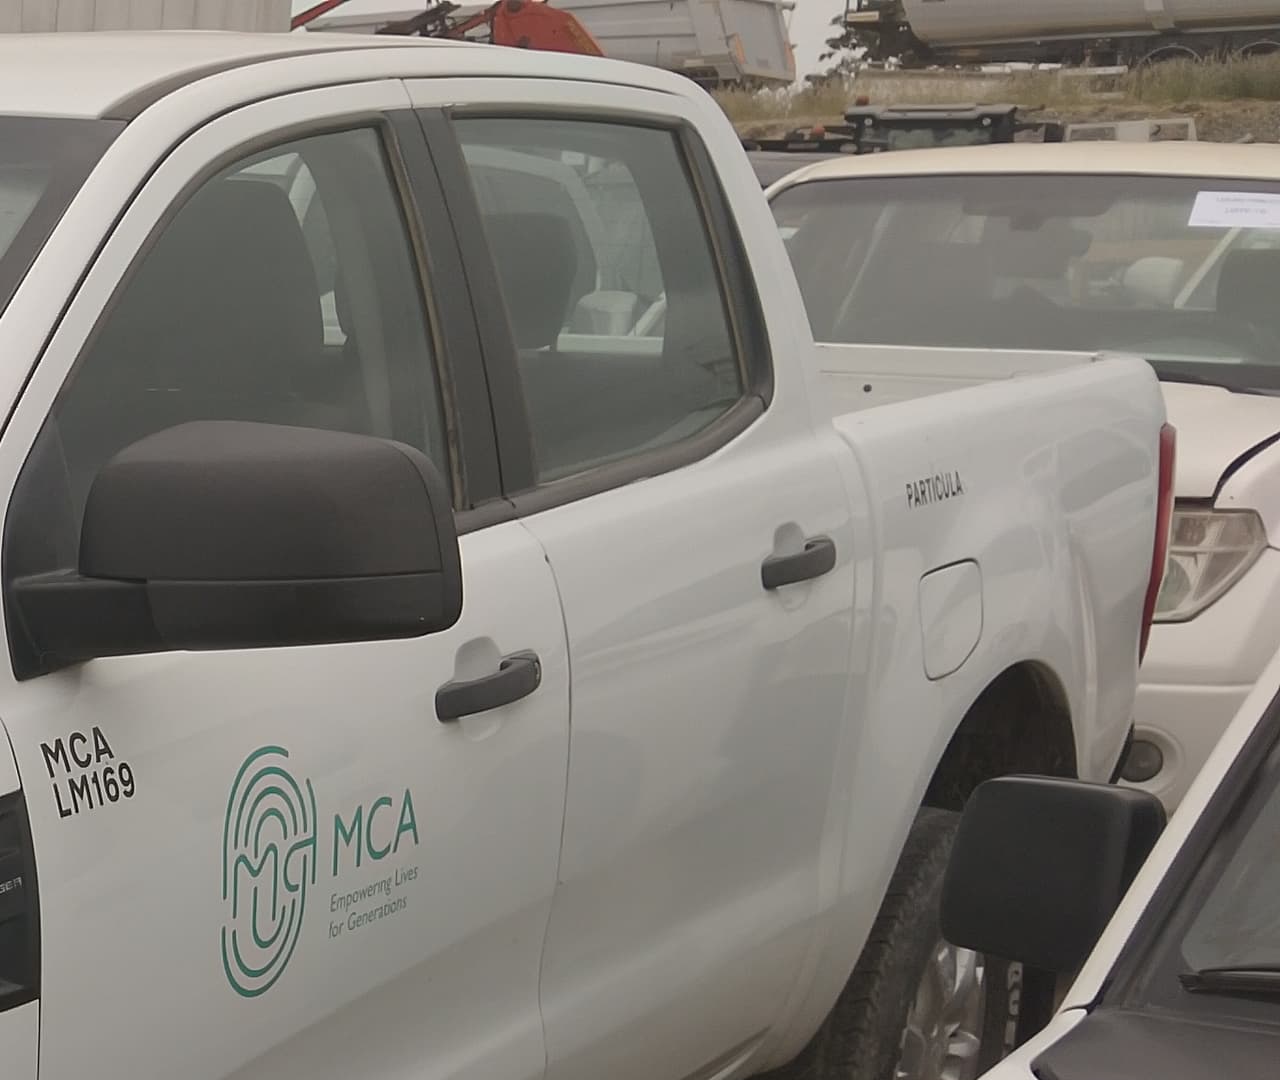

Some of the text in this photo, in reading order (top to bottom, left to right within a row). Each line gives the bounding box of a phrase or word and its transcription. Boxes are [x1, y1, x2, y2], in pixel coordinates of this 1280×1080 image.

[905, 471, 965, 510] PARTICULA
[40, 726, 115, 778] MCA
[52, 761, 136, 819] LM169
[332, 788, 420, 877] MCA
[329, 866, 419, 912] Empowering Lives
[328, 896, 407, 939] for Generations
